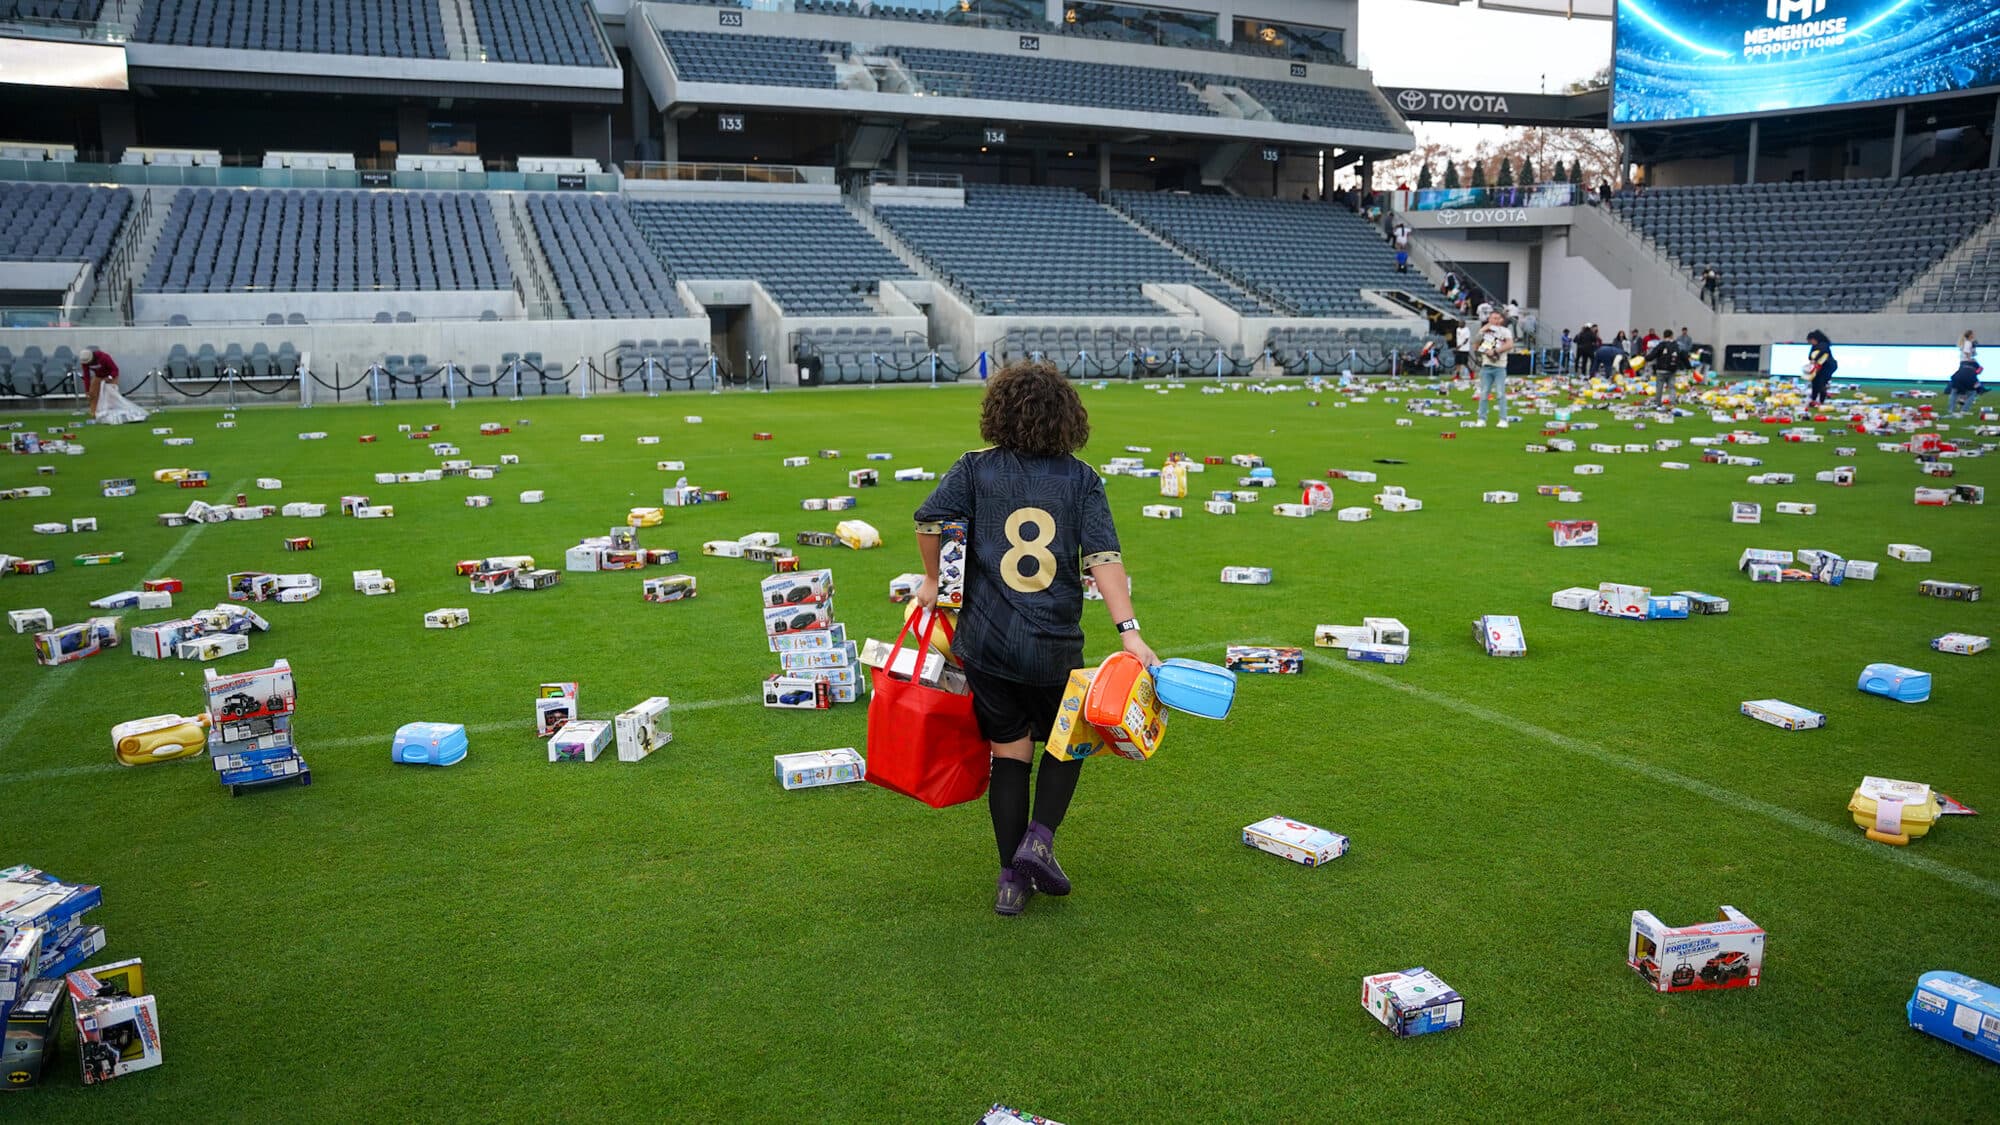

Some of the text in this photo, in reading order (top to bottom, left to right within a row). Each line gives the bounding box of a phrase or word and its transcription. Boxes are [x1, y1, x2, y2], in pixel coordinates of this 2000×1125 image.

[721, 14, 741, 25] 233
[1744, 17, 1848, 45] MEMEHOUSE
[1021, 39, 1038, 49] 234
[1743, 35, 1846, 57] PRODUCTIONS
[1291, 66, 1305, 76] 235
[1430, 93, 1509, 113] TOYOTA
[721, 117, 742, 130] 133
[986, 131, 1005, 143] 134
[1263, 150, 1278, 161] 135
[1463, 209, 1528, 222] TOYOTA
[1000, 507, 1057, 593] 8
[1665, 942, 1689, 954] FORD
